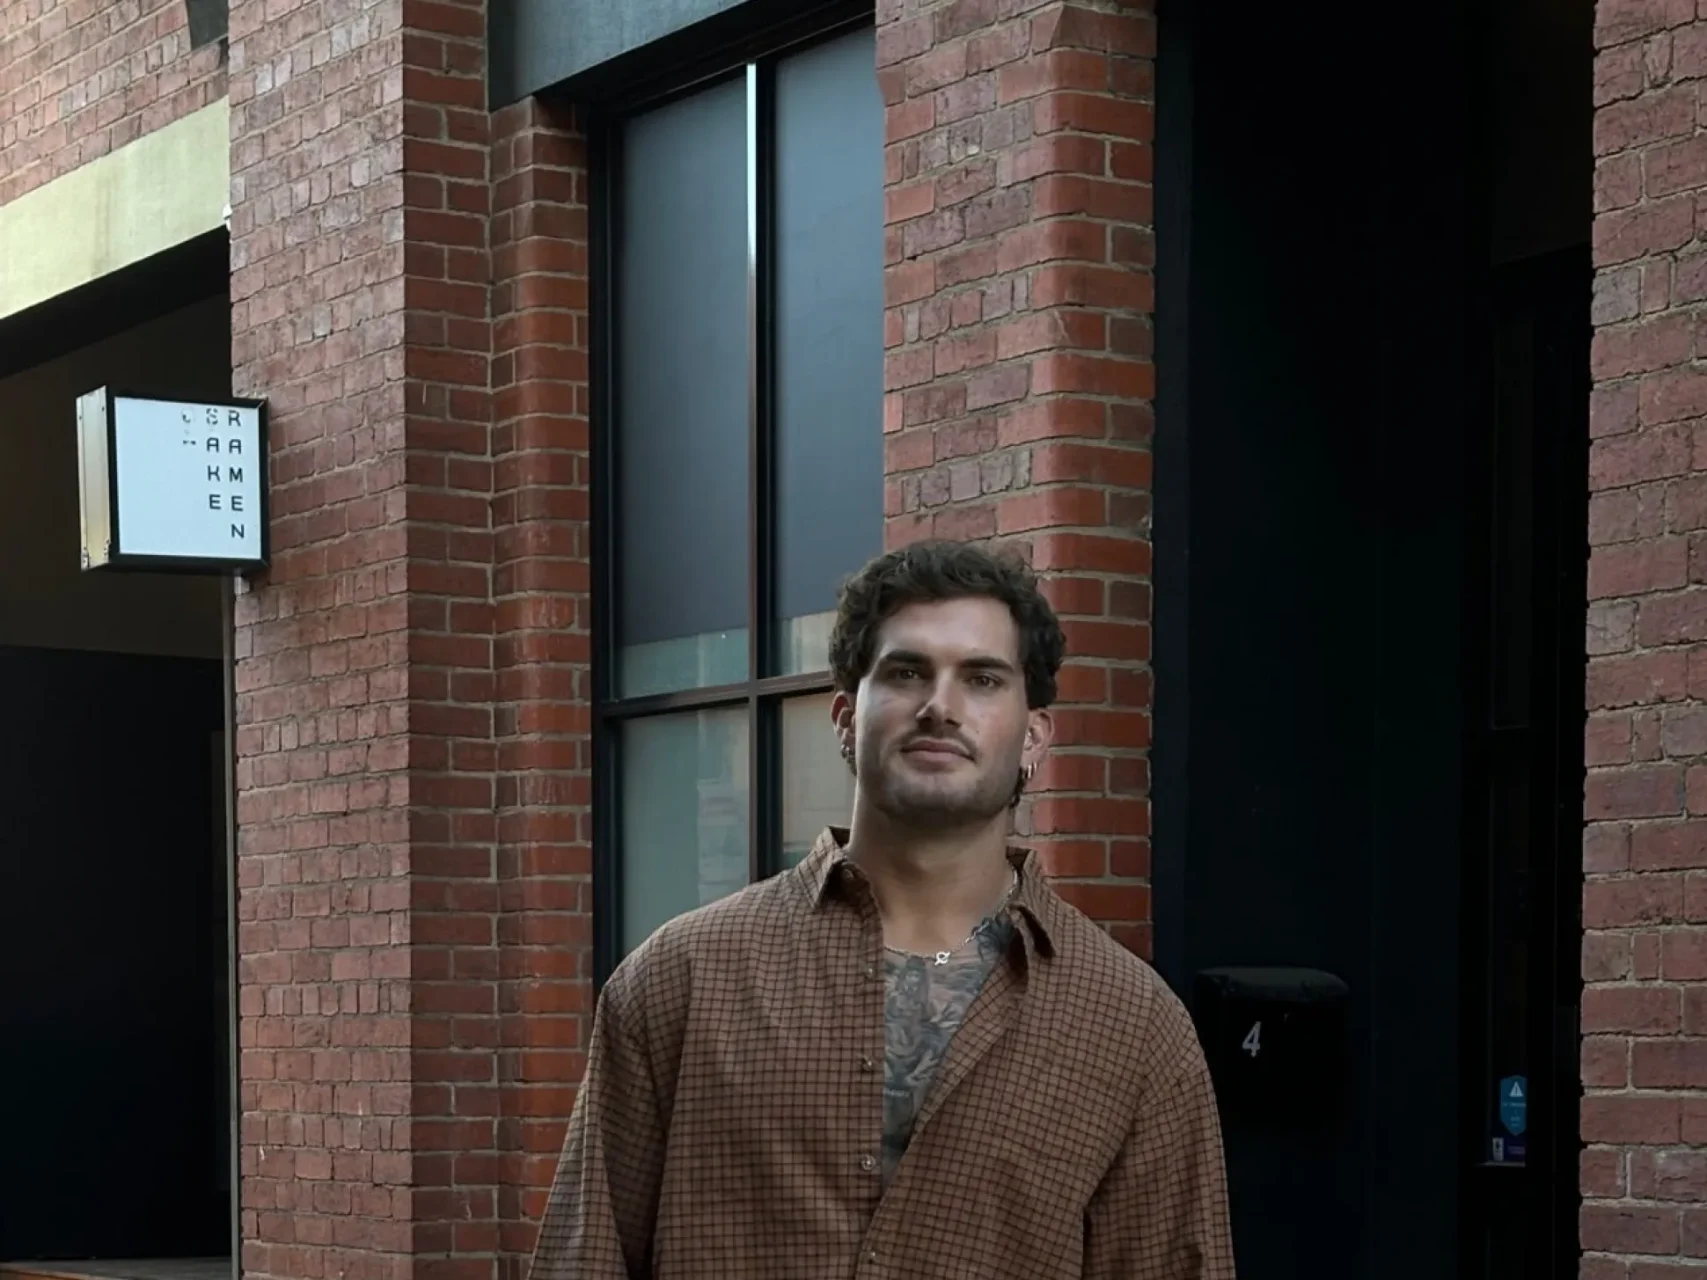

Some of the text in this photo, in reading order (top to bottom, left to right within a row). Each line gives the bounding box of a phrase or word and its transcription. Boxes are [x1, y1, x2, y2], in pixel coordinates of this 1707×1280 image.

[206, 408, 222, 510] SAKE
[228, 409, 245, 539] RAMEN
[1242, 1020, 1261, 1057] 4
